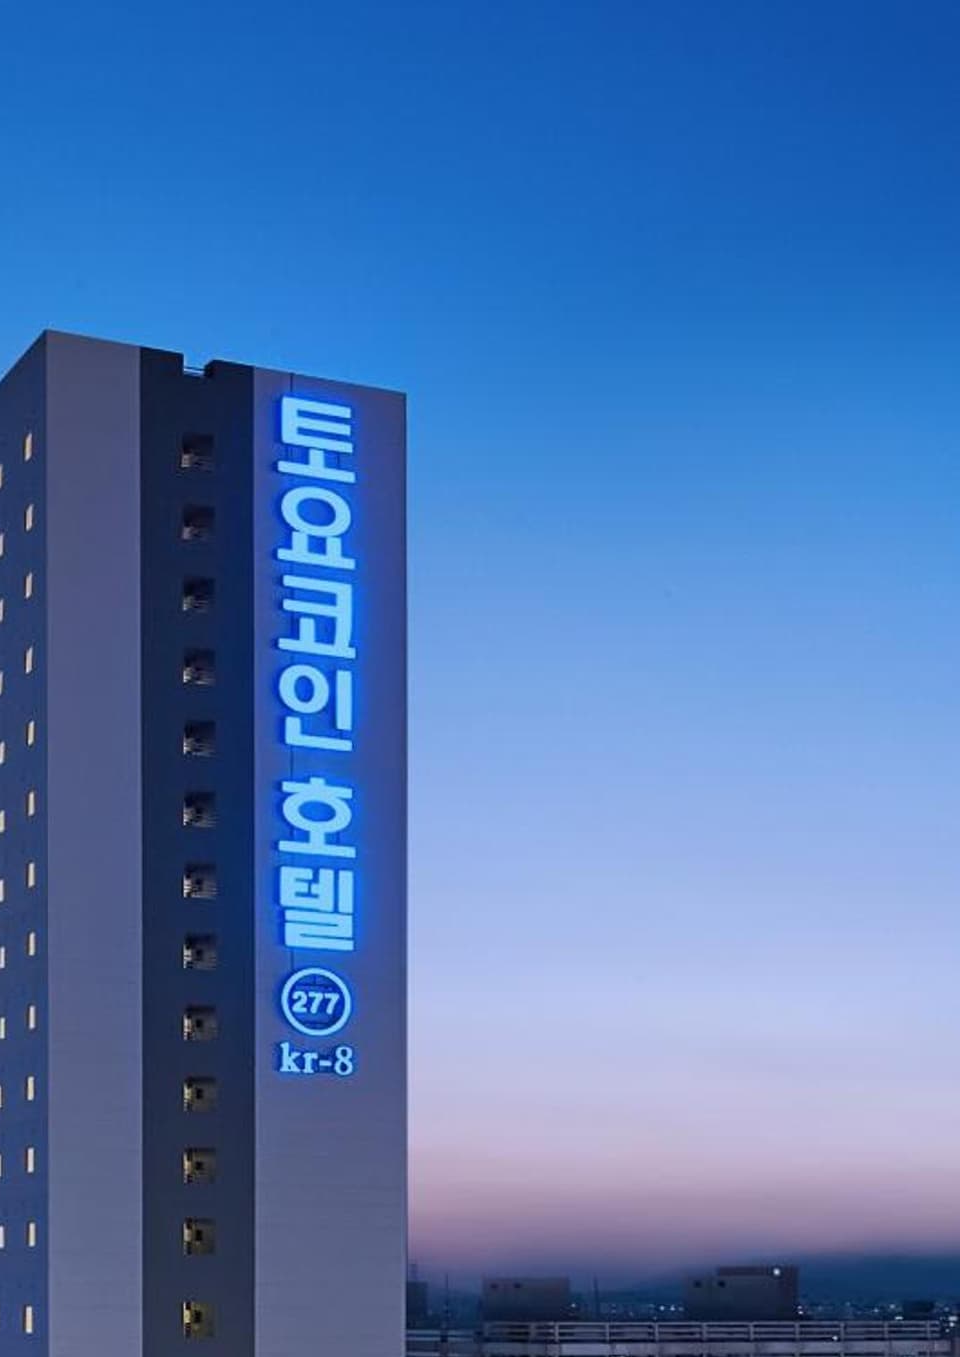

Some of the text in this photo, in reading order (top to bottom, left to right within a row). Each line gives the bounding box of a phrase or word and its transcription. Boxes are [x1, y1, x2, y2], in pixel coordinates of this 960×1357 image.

[277, 396, 356, 950] 토요코인 호텔
[291, 990, 340, 1015] 277
[279, 1042, 354, 1076] kr-8
